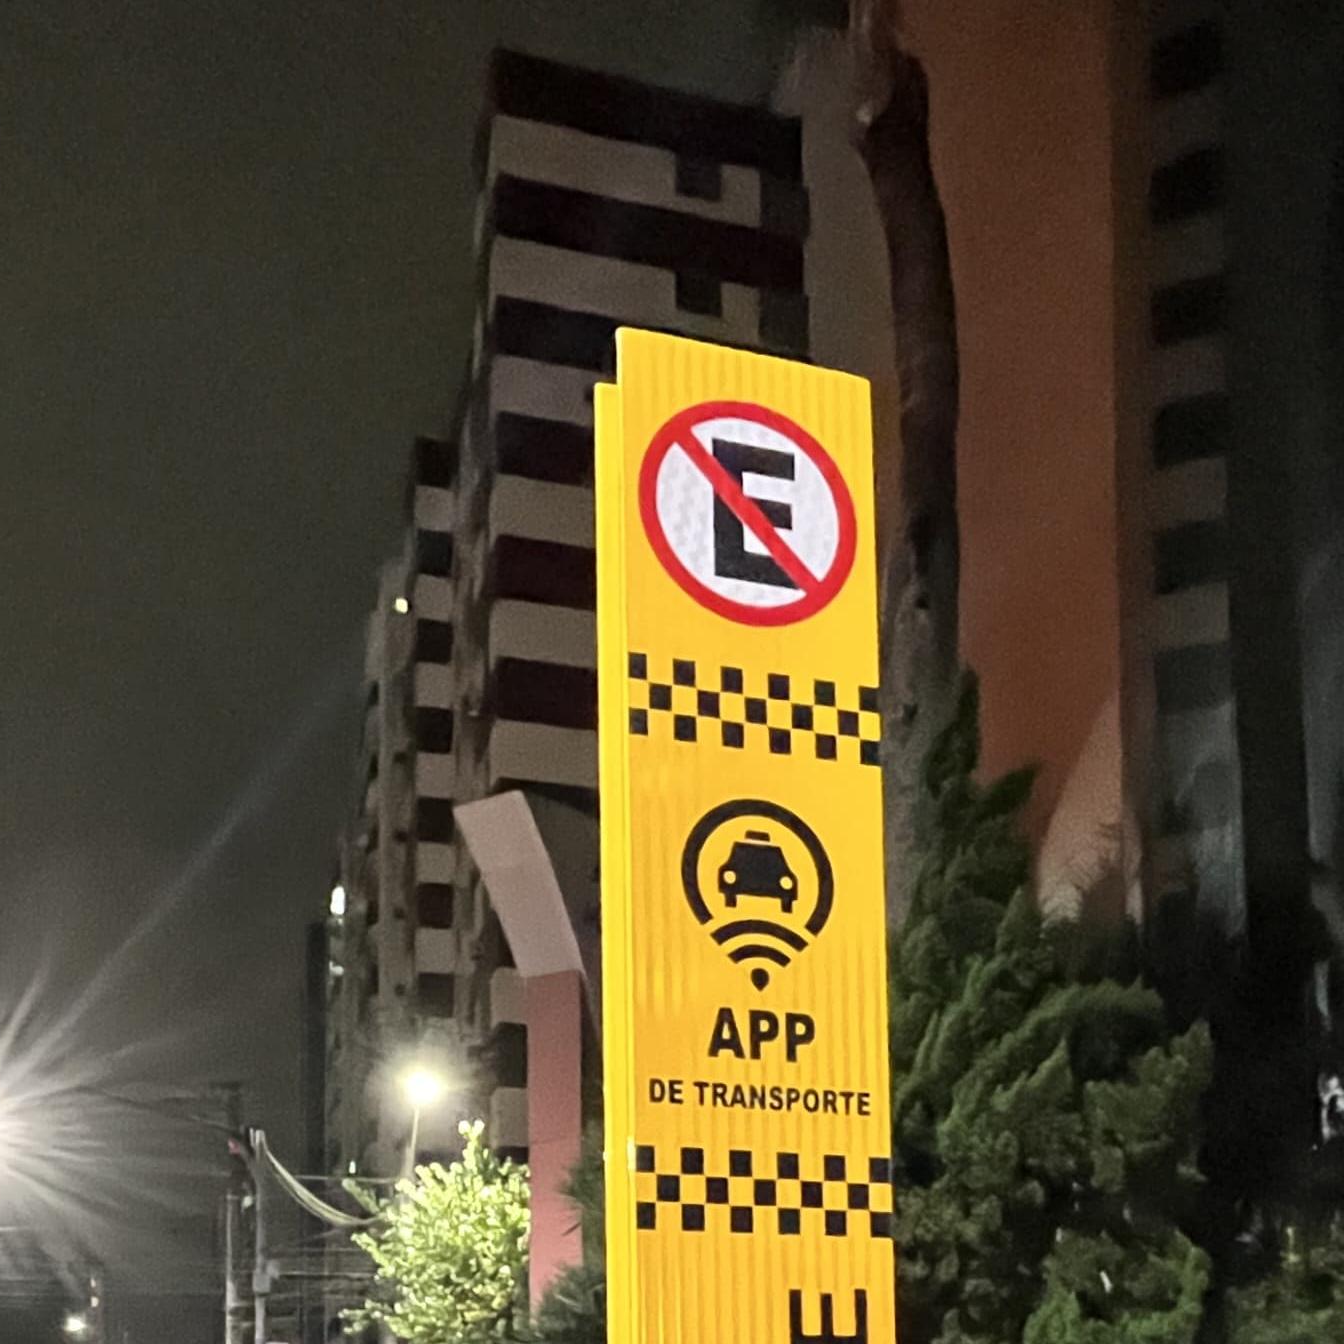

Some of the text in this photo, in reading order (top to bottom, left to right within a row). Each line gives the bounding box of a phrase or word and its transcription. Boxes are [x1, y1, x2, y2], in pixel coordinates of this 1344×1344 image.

[707, 1006, 816, 1063] APP
[648, 1077, 872, 1116] DE TRANSPORTE
